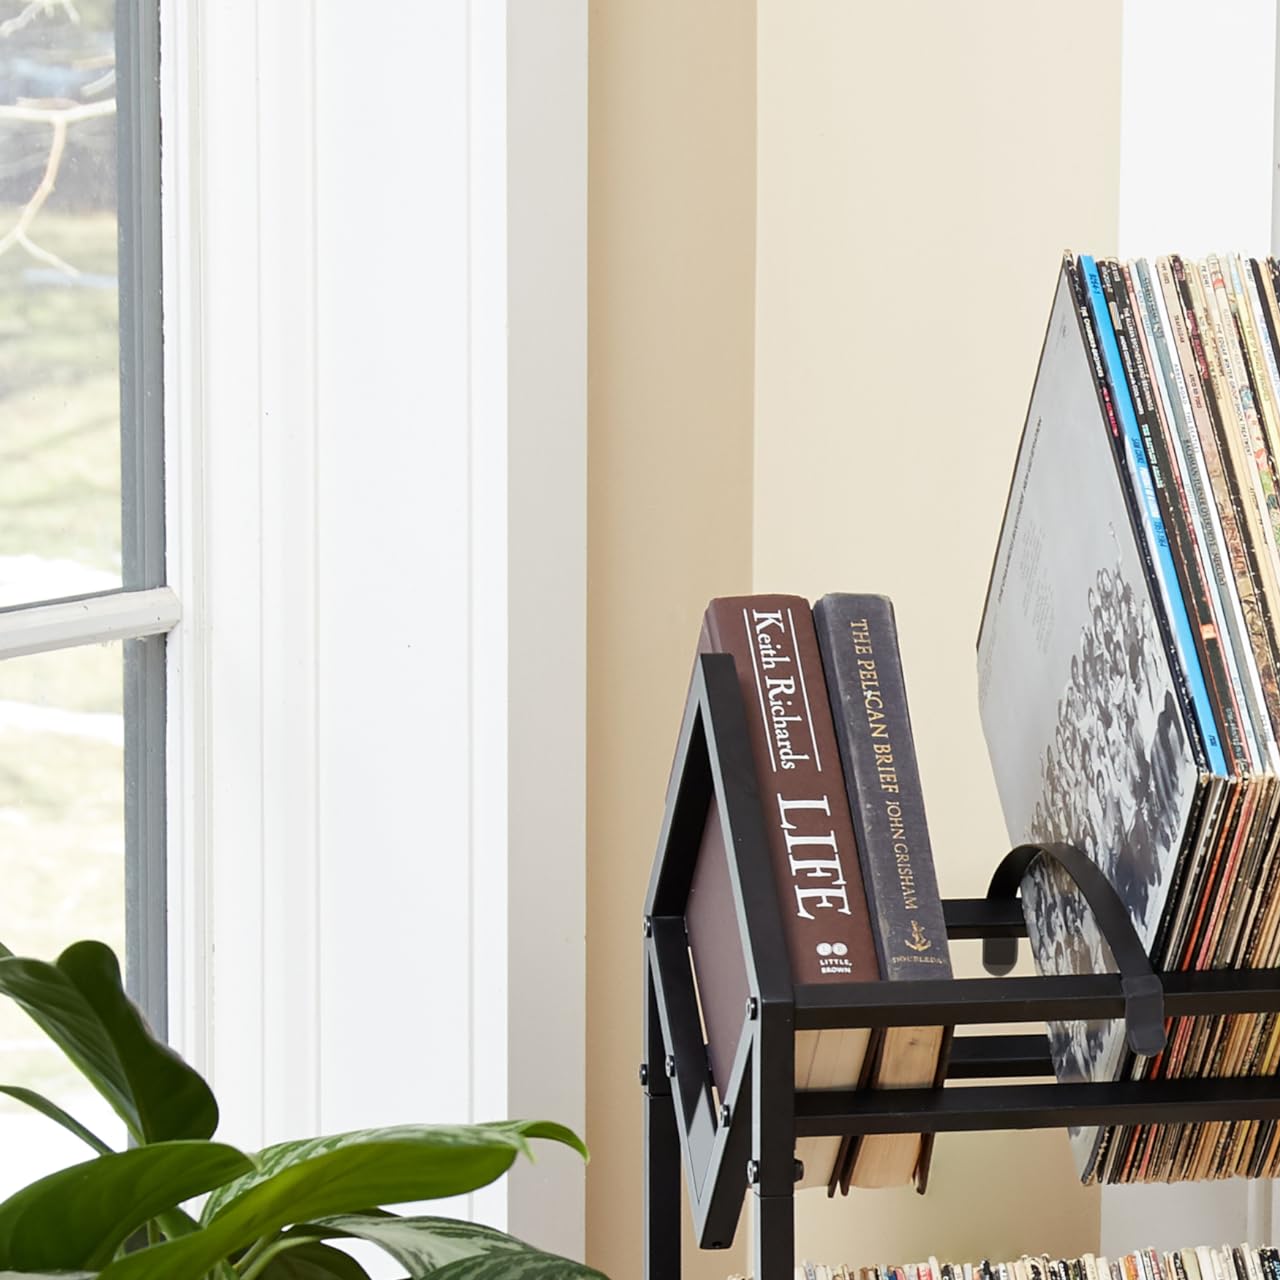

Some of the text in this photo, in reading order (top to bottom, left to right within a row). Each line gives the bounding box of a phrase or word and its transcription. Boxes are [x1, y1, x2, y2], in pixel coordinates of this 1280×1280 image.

[1125, 318, 1134, 336] ALLMAN
[1131, 437, 1140, 448] SAM
[1182, 439, 1226, 585] BACHMAN-TURNER OVERDRIVE MERCURY
[752, 609, 810, 770] Keith Richards
[850, 619, 899, 794] THE PELICAN BRIEF
[777, 793, 852, 920] LIFE
[885, 800, 919, 911] JOHN GRISHAM
[819, 958, 853, 967] LITTLE,
